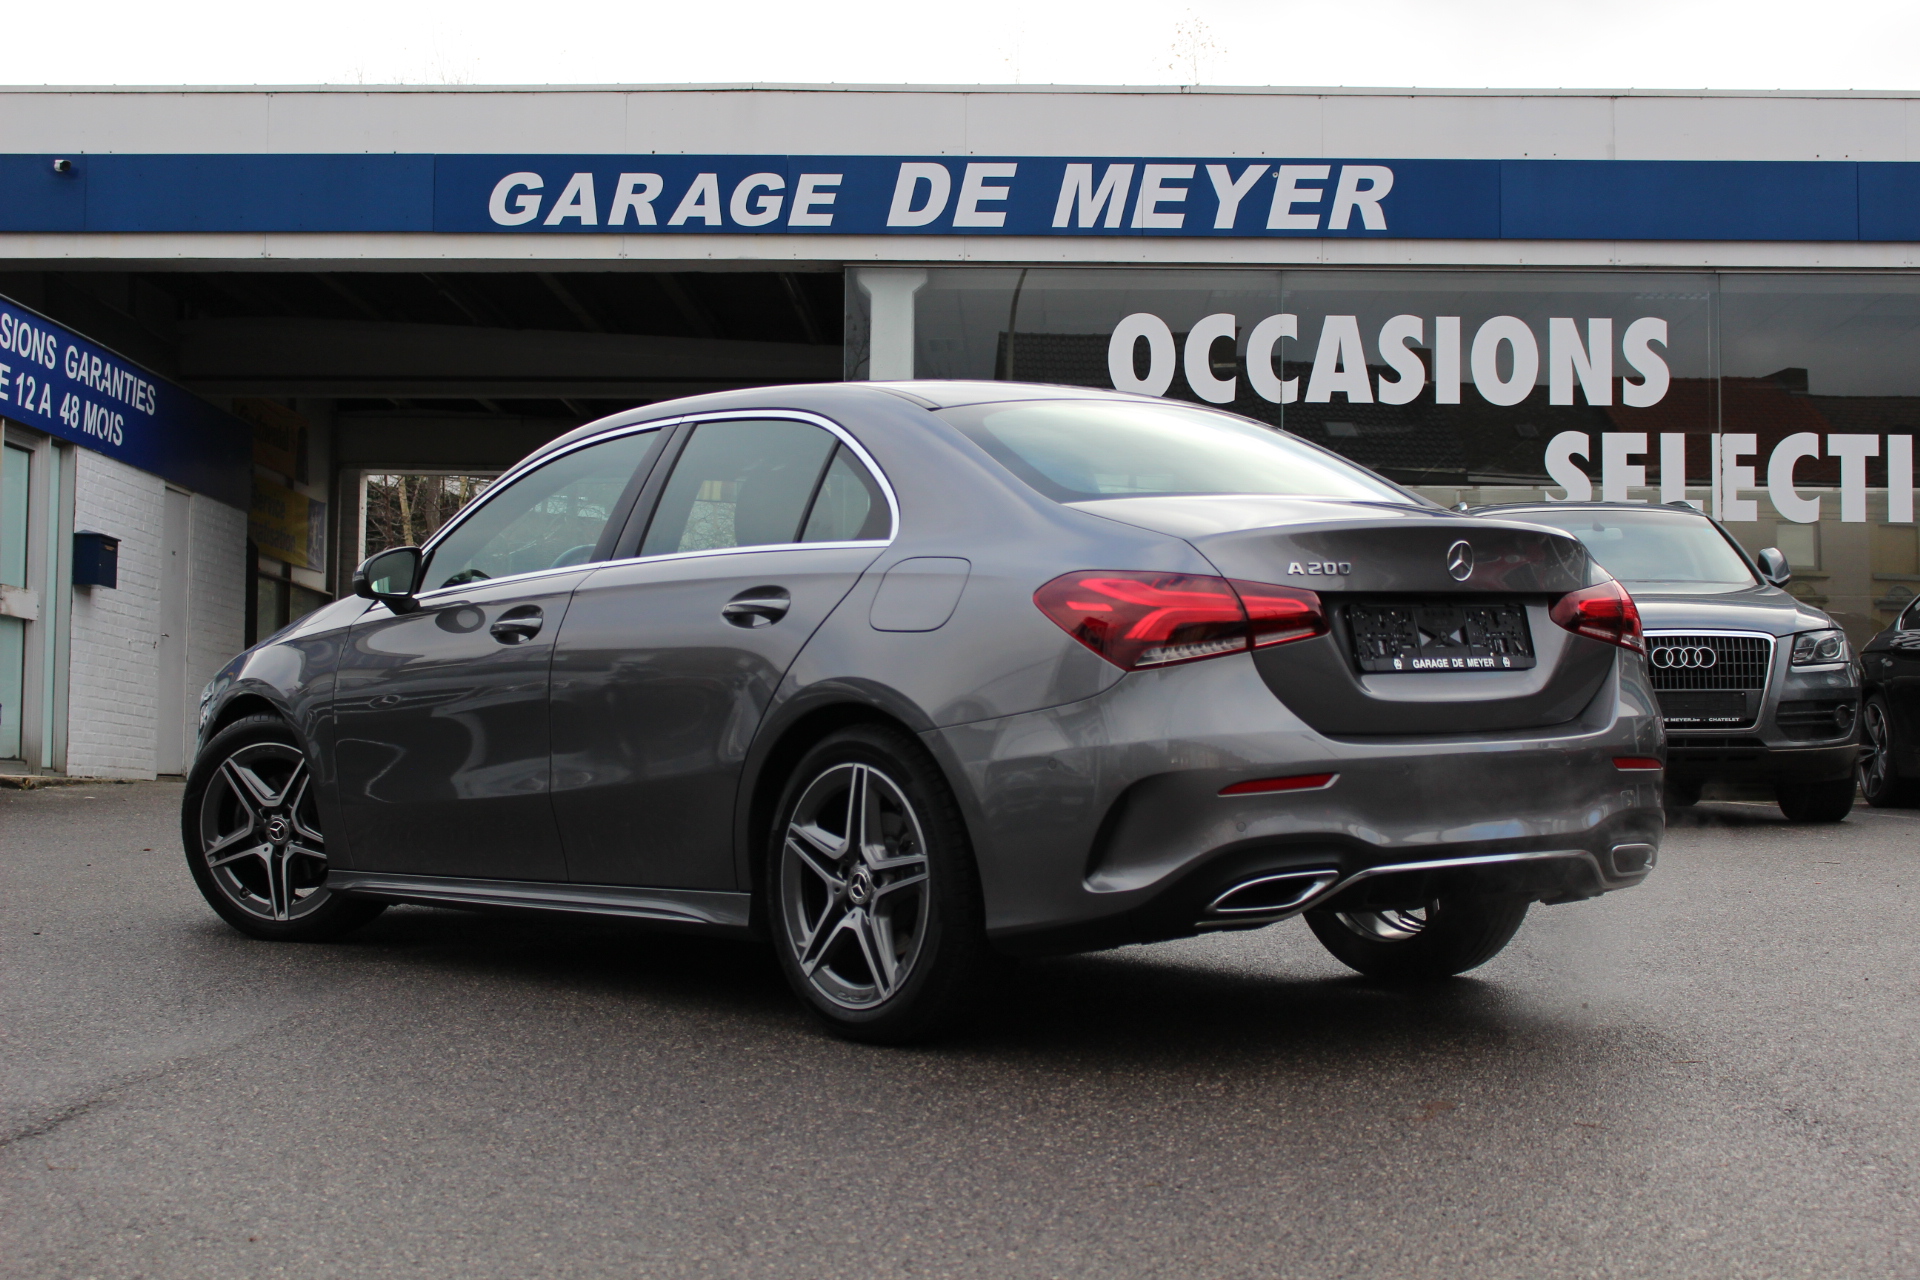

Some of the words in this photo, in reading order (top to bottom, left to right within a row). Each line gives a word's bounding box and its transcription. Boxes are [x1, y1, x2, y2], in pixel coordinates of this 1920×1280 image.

[488, 172, 844, 229] GARAGE
[887, 163, 1018, 229] DE
[1052, 163, 1395, 231] MEYER
[0, 313, 57, 370] SIONS
[65, 345, 156, 416] GARANTIES
[1108, 313, 1669, 408] OCCASIONS
[16, 372, 35, 411] 12
[38, 383, 51, 418] A
[60, 392, 80, 429] 48
[83, 400, 124, 446] MOIS
[1544, 431, 1914, 523] SELECTI
[1412, 658, 1449, 669] GARAGE
[1452, 658, 1464, 668] DE
[1466, 658, 1495, 668] MEYER
